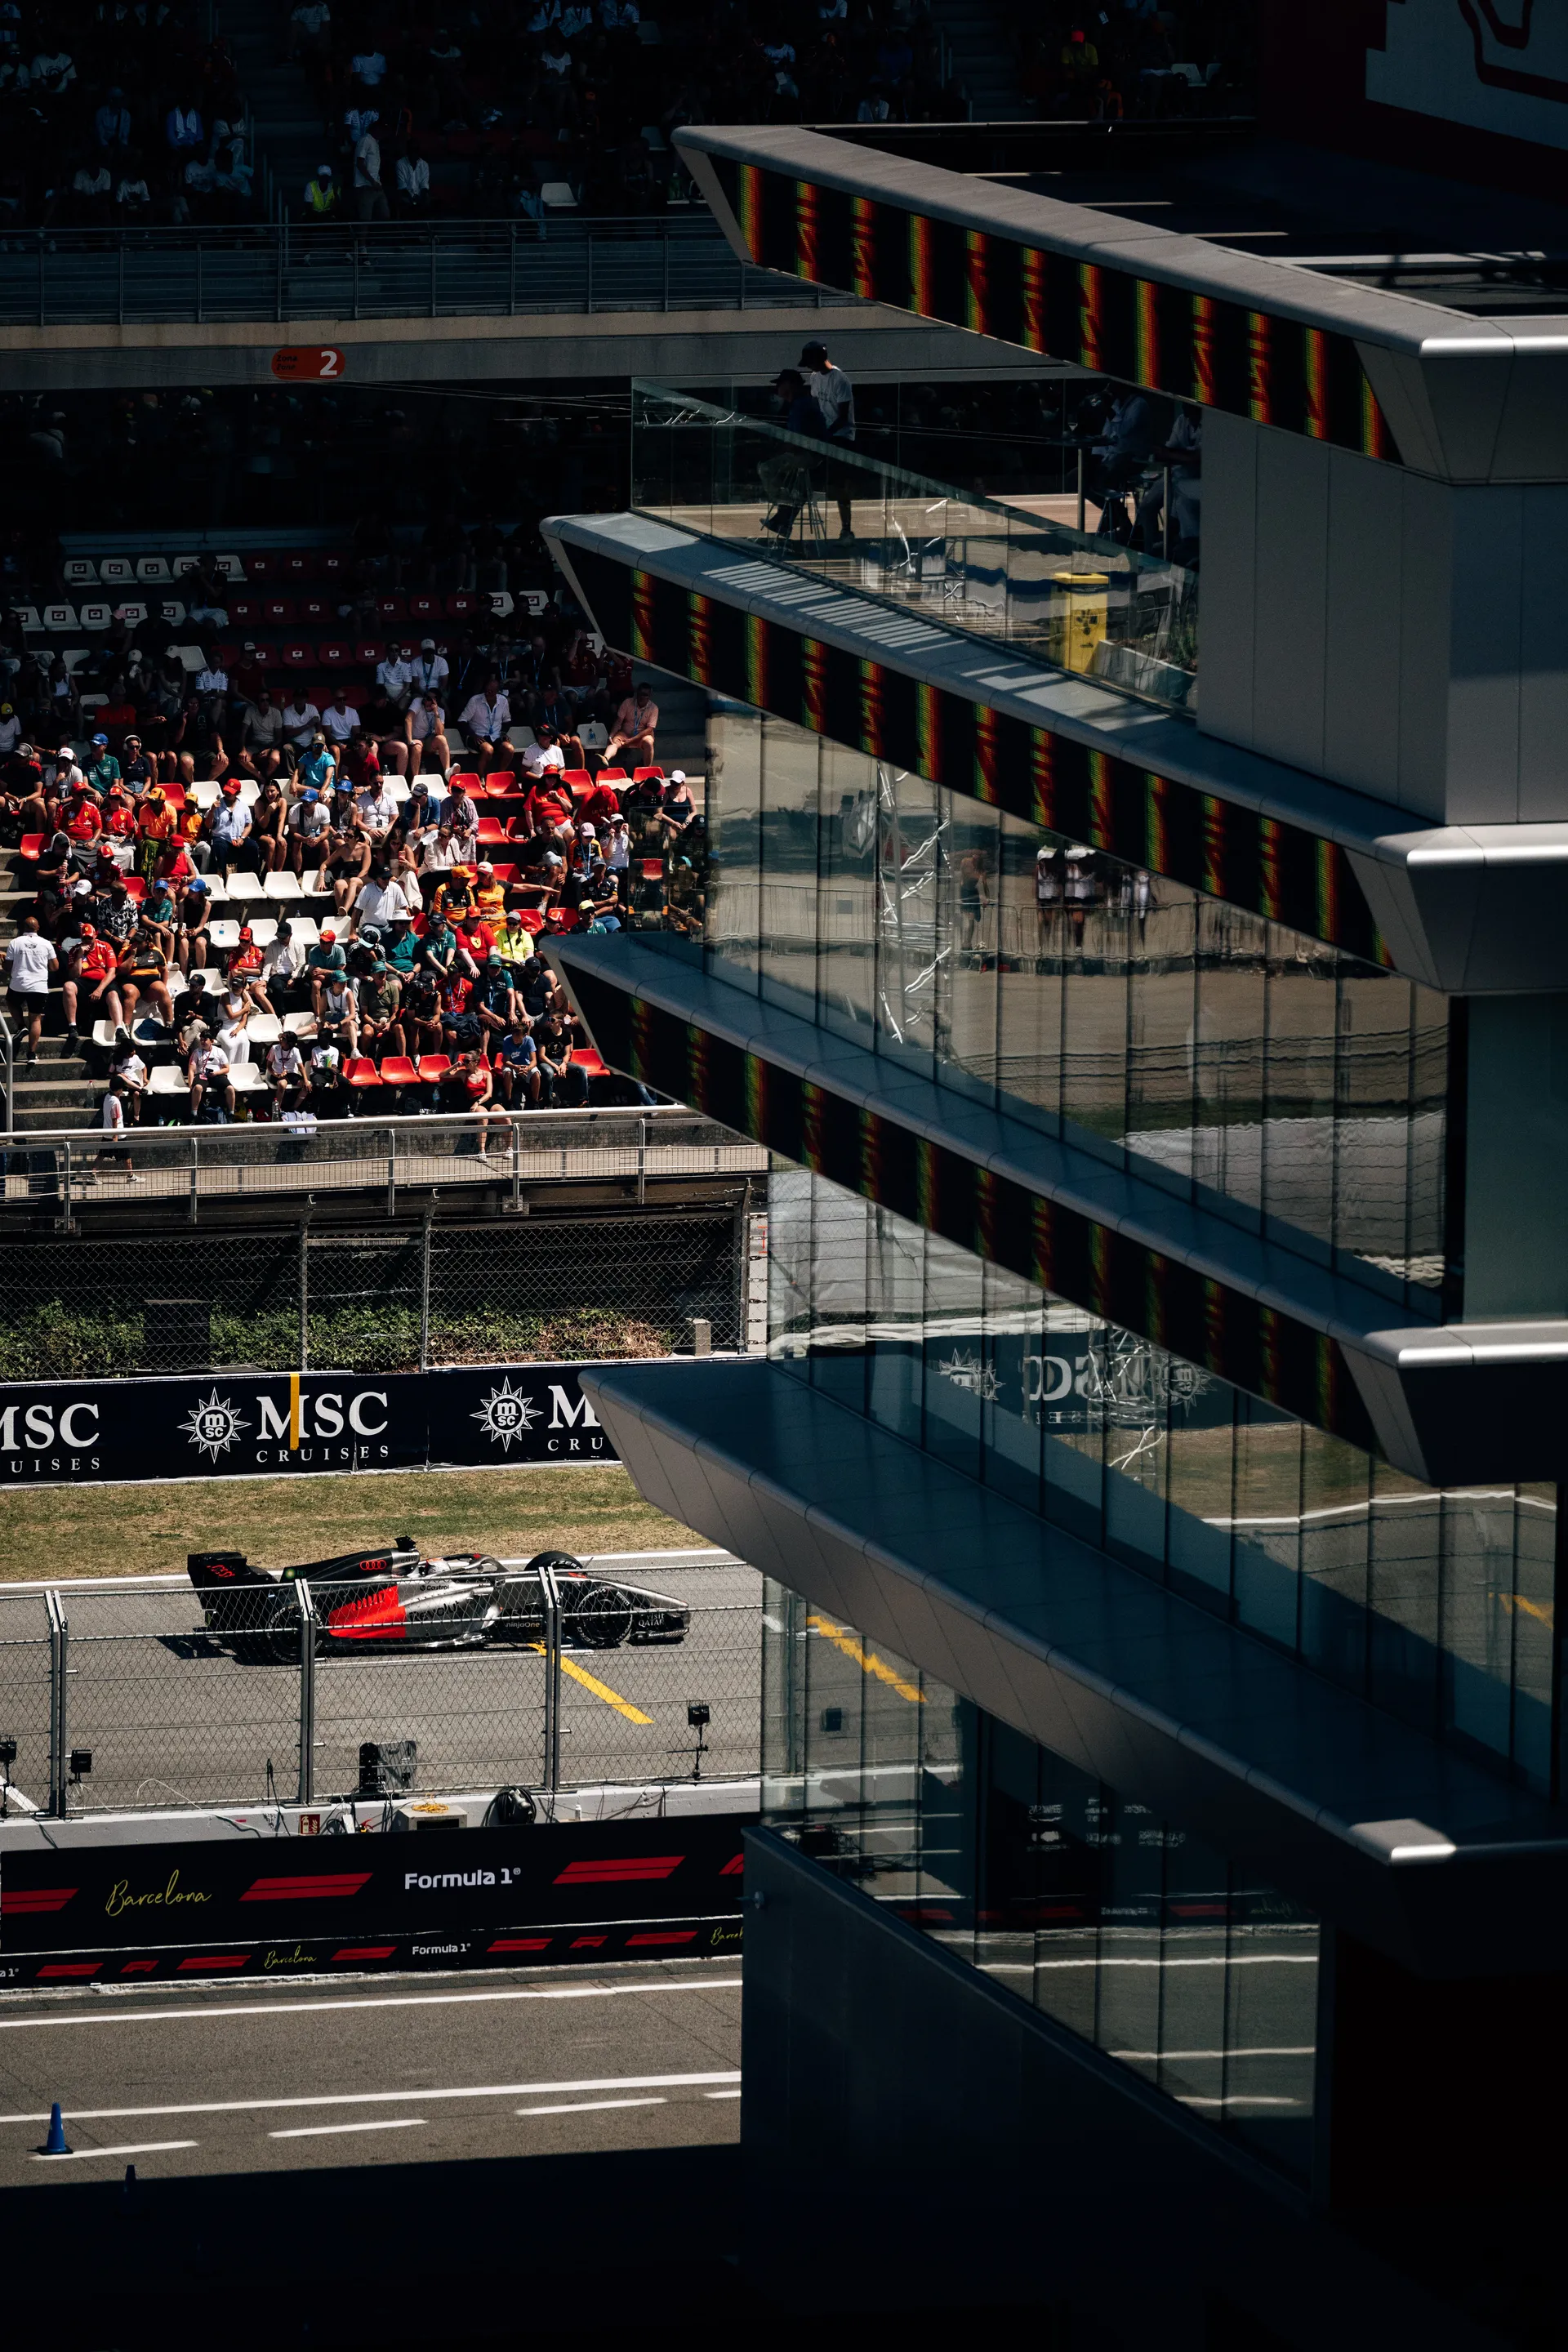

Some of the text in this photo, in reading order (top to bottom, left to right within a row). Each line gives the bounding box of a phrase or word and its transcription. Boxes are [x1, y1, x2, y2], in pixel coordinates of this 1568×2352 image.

[319, 350, 337, 376] 2
[256, 1391, 388, 1440] MSC
[256, 1445, 389, 1463] CRUISES
[11, 1458, 100, 1473] UISES
[506, 1621, 540, 1629] ninjaOne
[638, 1619, 666, 1628] QATAR
[404, 1868, 496, 1891] Formula
[105, 1869, 212, 1917] Barcelona
[710, 1927, 744, 1945] Barcel
[264, 1944, 318, 1969] Barcelona
[412, 1944, 459, 1956] Formula
